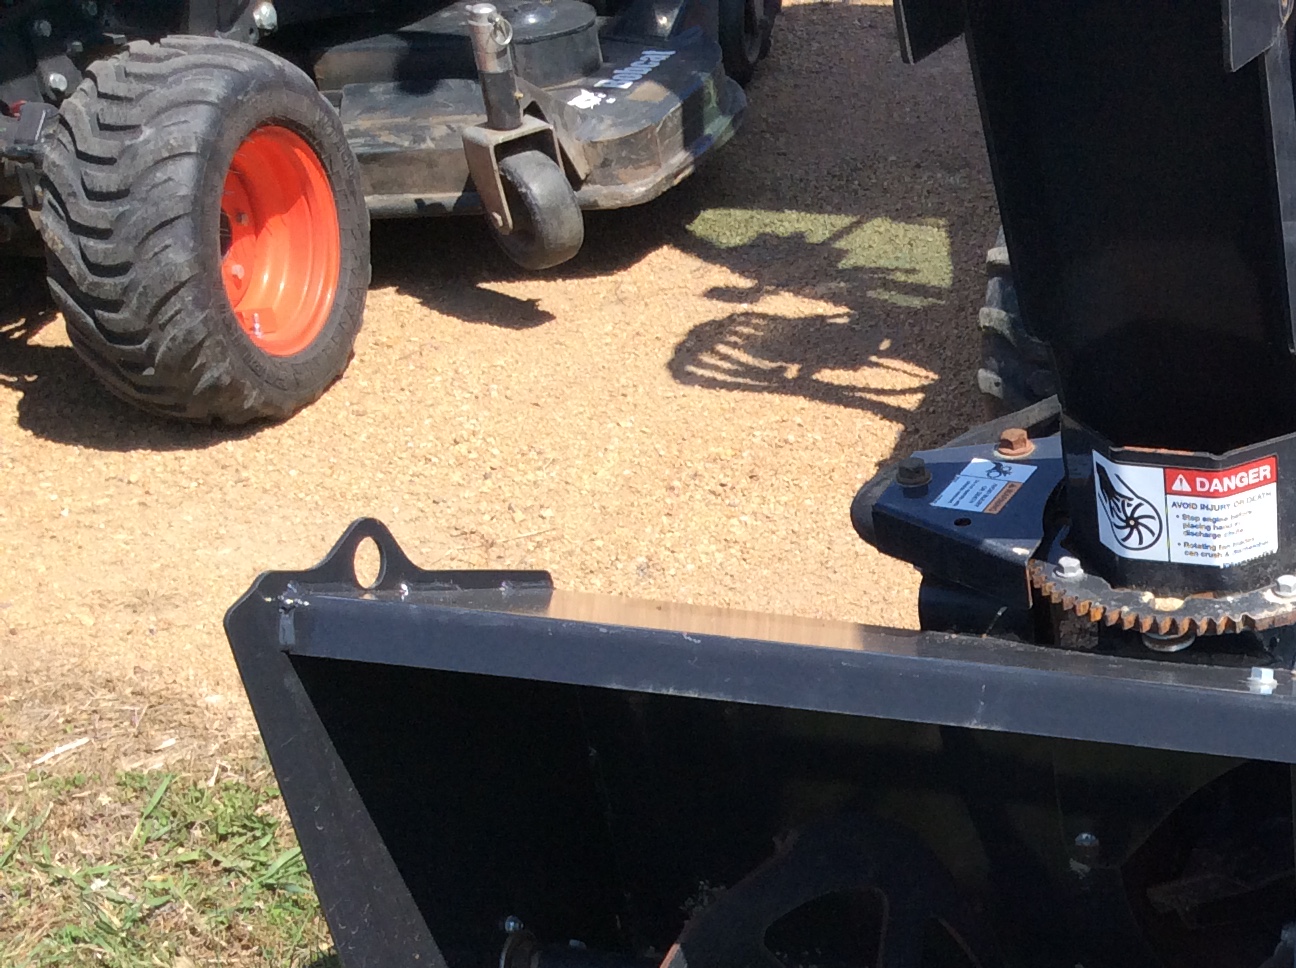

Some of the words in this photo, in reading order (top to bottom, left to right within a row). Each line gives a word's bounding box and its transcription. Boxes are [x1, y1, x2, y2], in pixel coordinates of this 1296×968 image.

[593, 50, 677, 89] Bobcat
[1196, 465, 1271, 493] DANGER
[1171, 501, 1198, 510] AVOID
[1200, 503, 1230, 511] INJURY
[1182, 513, 1200, 522] Stop
